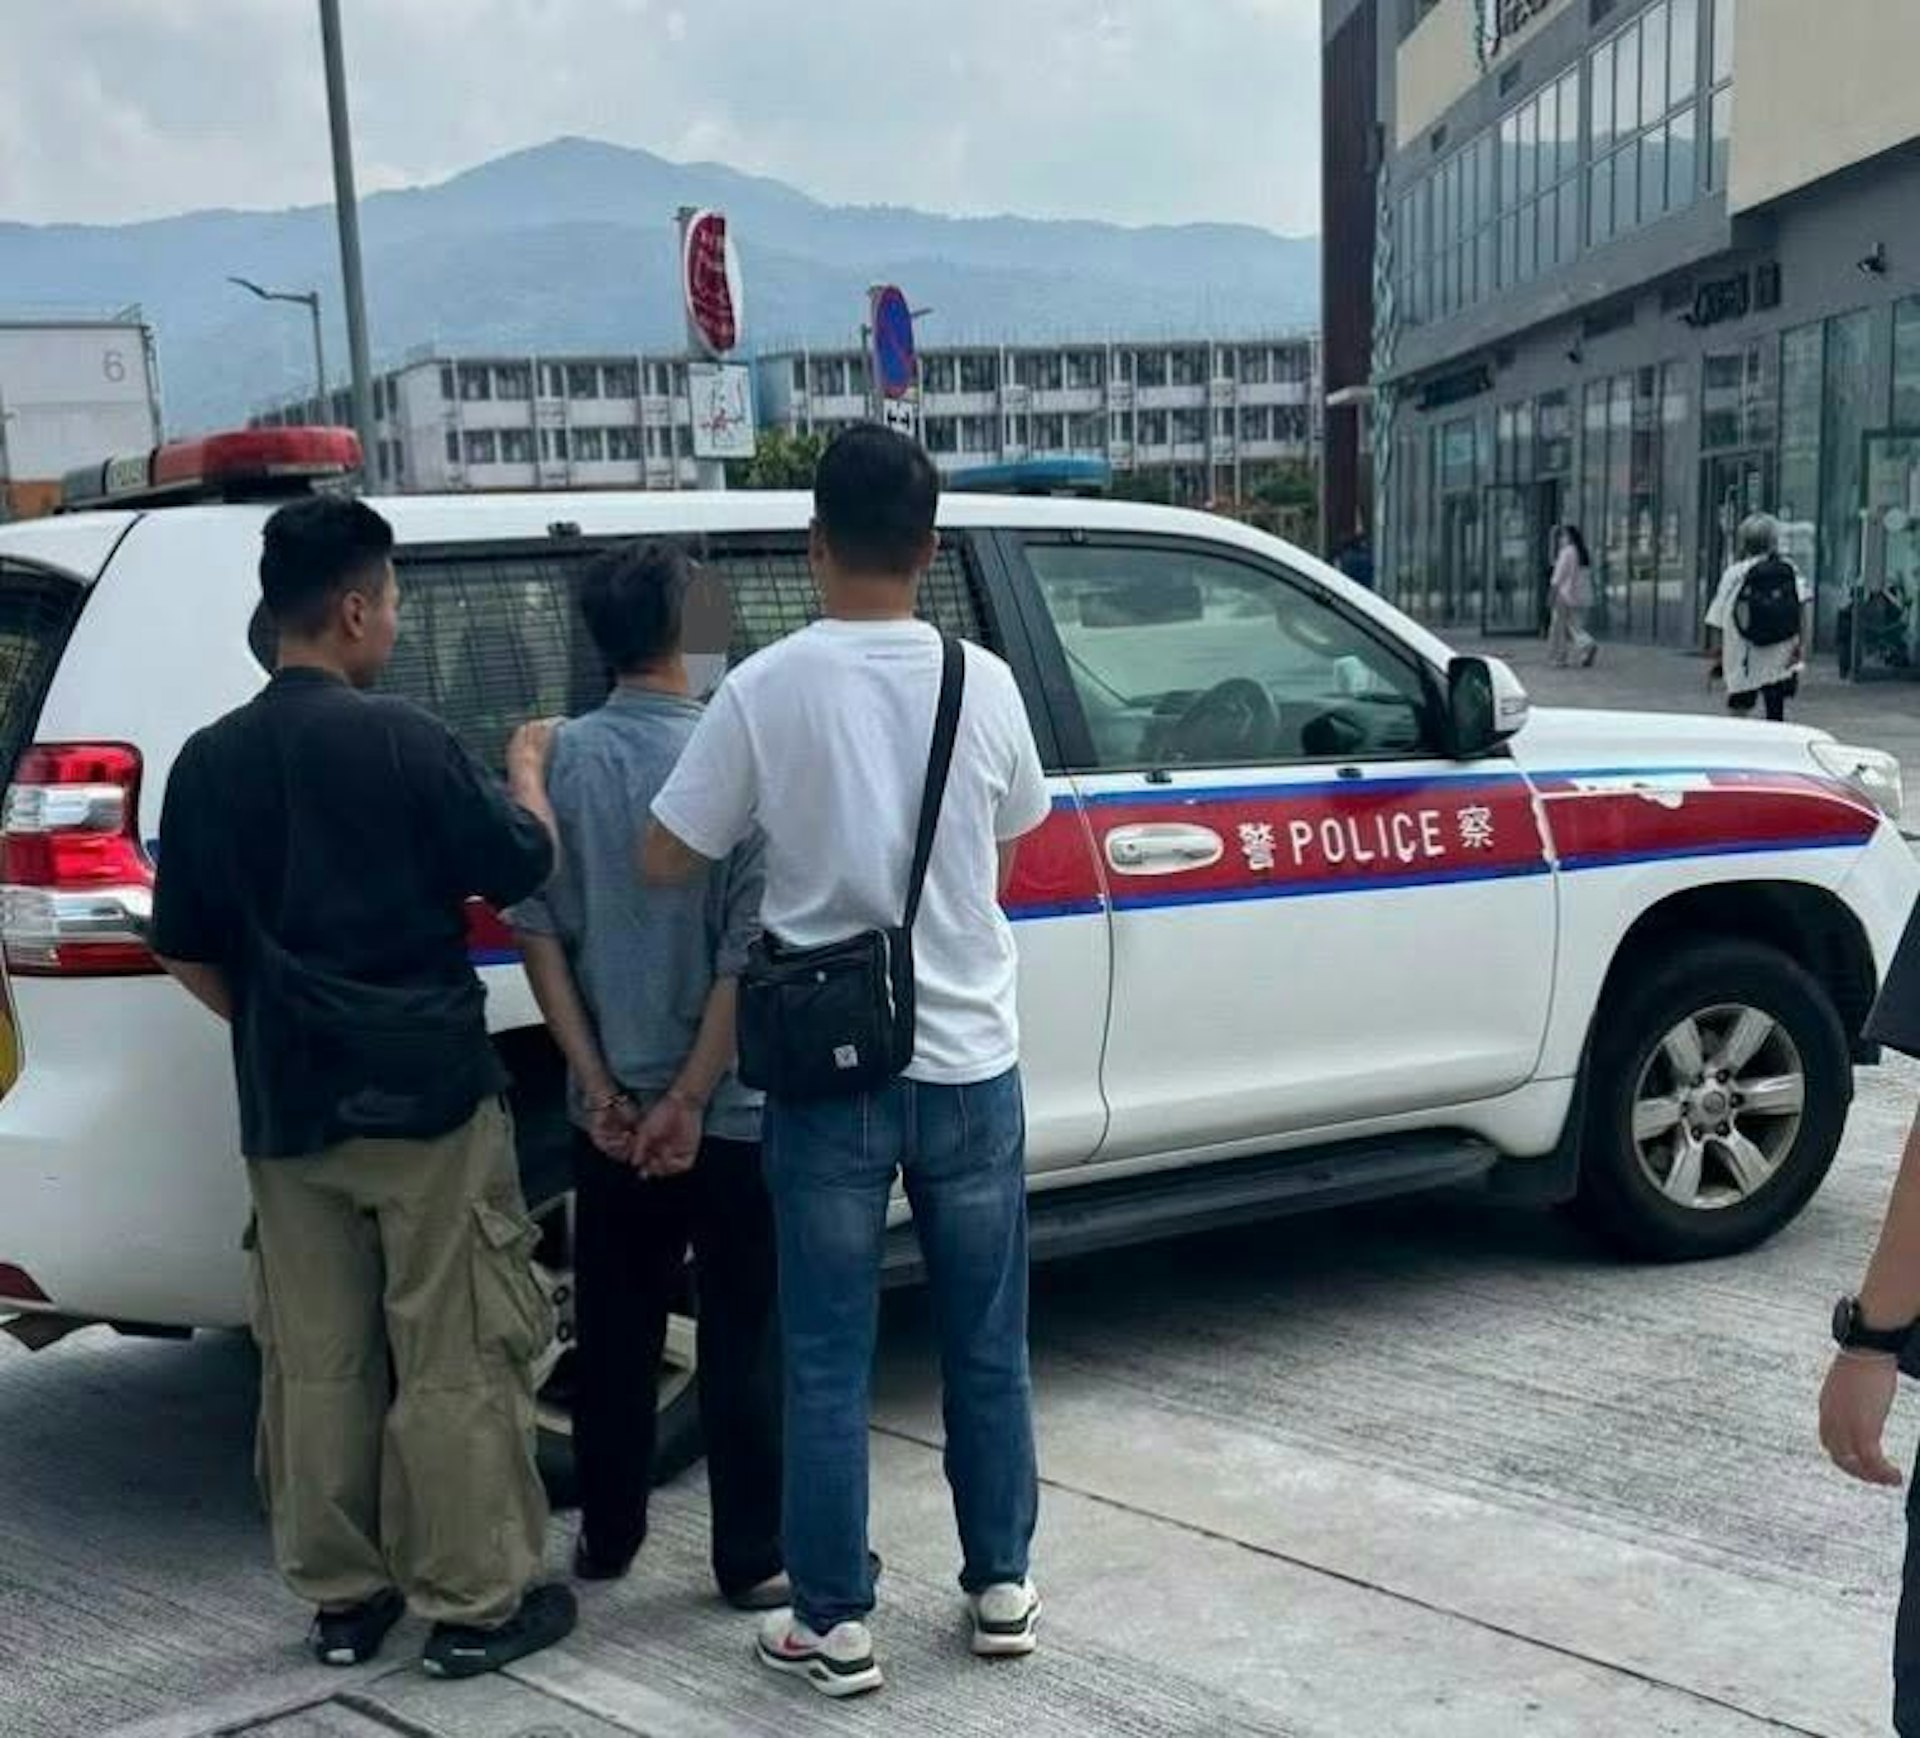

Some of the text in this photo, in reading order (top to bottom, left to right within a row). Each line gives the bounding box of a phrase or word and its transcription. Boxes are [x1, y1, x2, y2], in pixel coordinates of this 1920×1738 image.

[103, 350, 125, 382] 6
[1238, 804, 1494, 870] 警 POLICE 察
